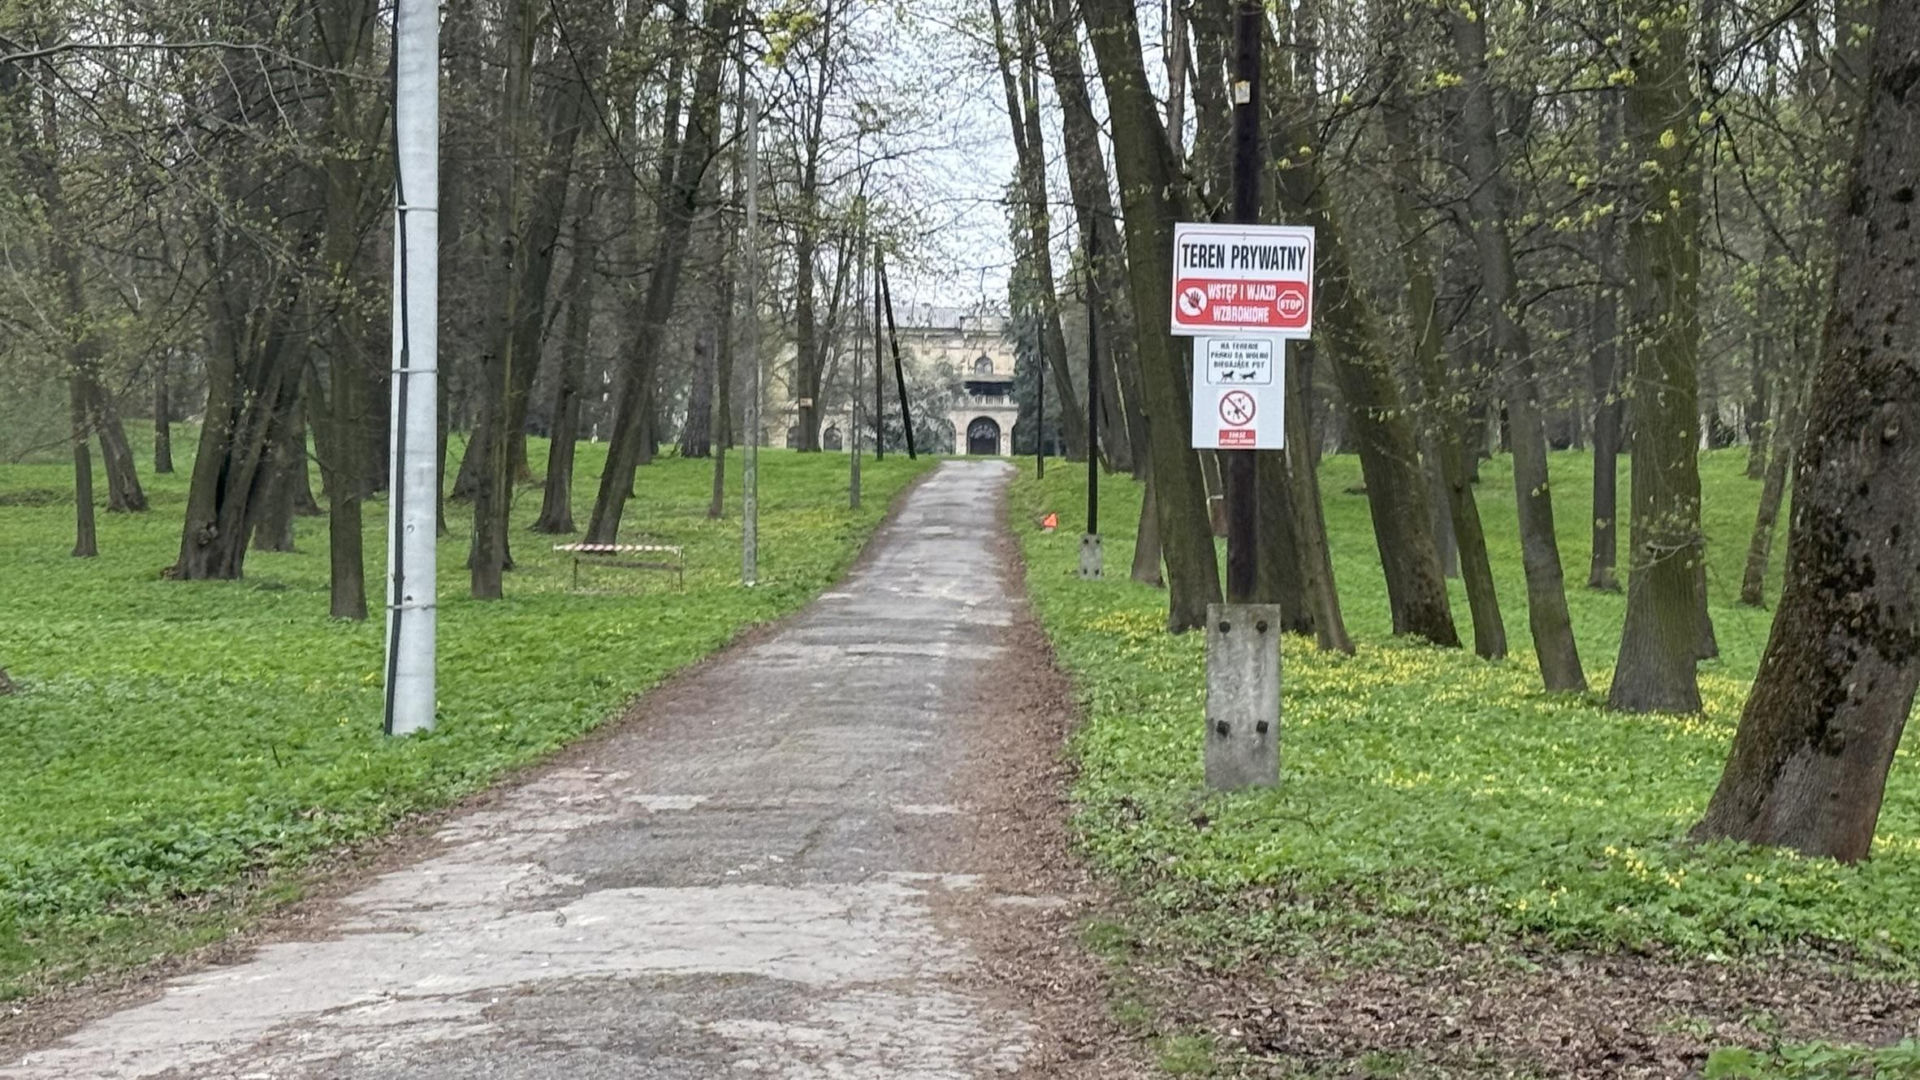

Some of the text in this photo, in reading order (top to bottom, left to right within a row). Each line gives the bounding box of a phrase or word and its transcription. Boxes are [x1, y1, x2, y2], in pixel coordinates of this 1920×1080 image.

[1182, 244, 1306, 271] TEREN PRYWATNY
[1207, 284, 1277, 303] WSTĘP I WJAZD
[1280, 299, 1302, 310] STOP
[1213, 305, 1270, 323] WZBRONIONE
